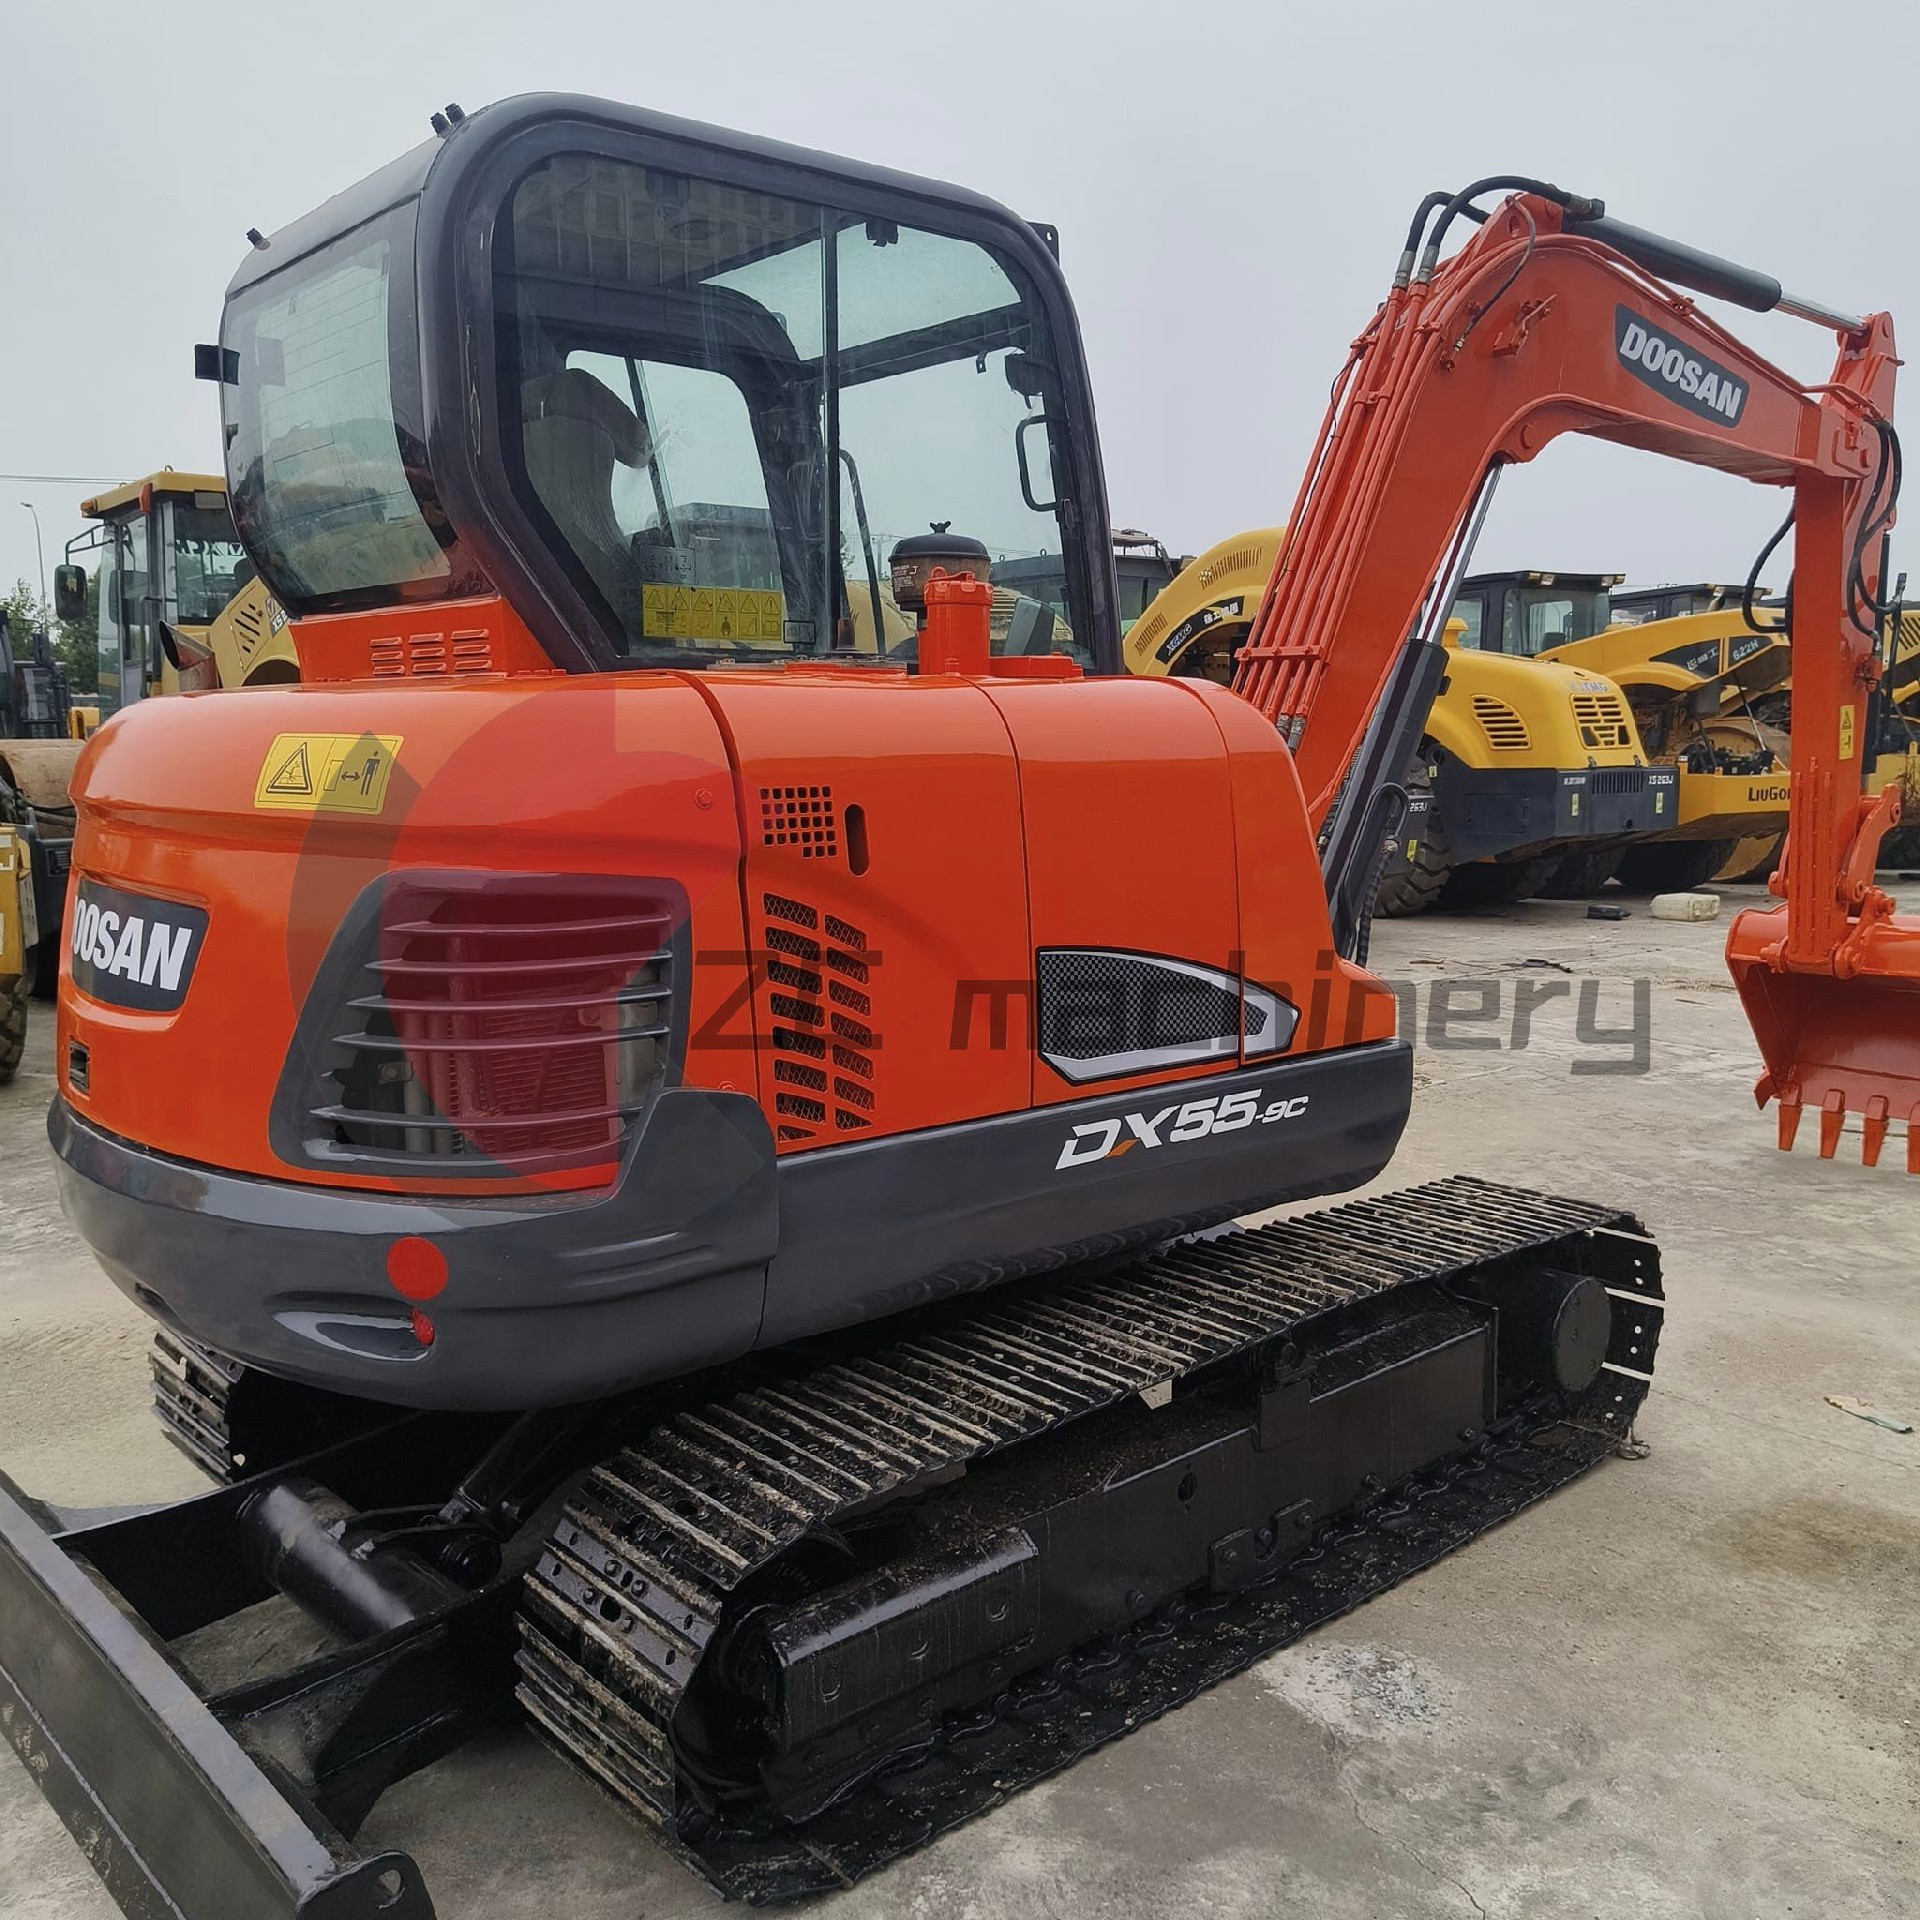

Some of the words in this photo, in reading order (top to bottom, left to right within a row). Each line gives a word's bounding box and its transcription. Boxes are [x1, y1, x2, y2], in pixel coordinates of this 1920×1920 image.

[1619, 322, 1742, 419] DOOSAN
[1166, 623, 1193, 656] XCMG
[1732, 639, 1759, 661] 622H
[72, 894, 193, 991] OOSAN
[1055, 1088, 1309, 1170] DX55-9C
